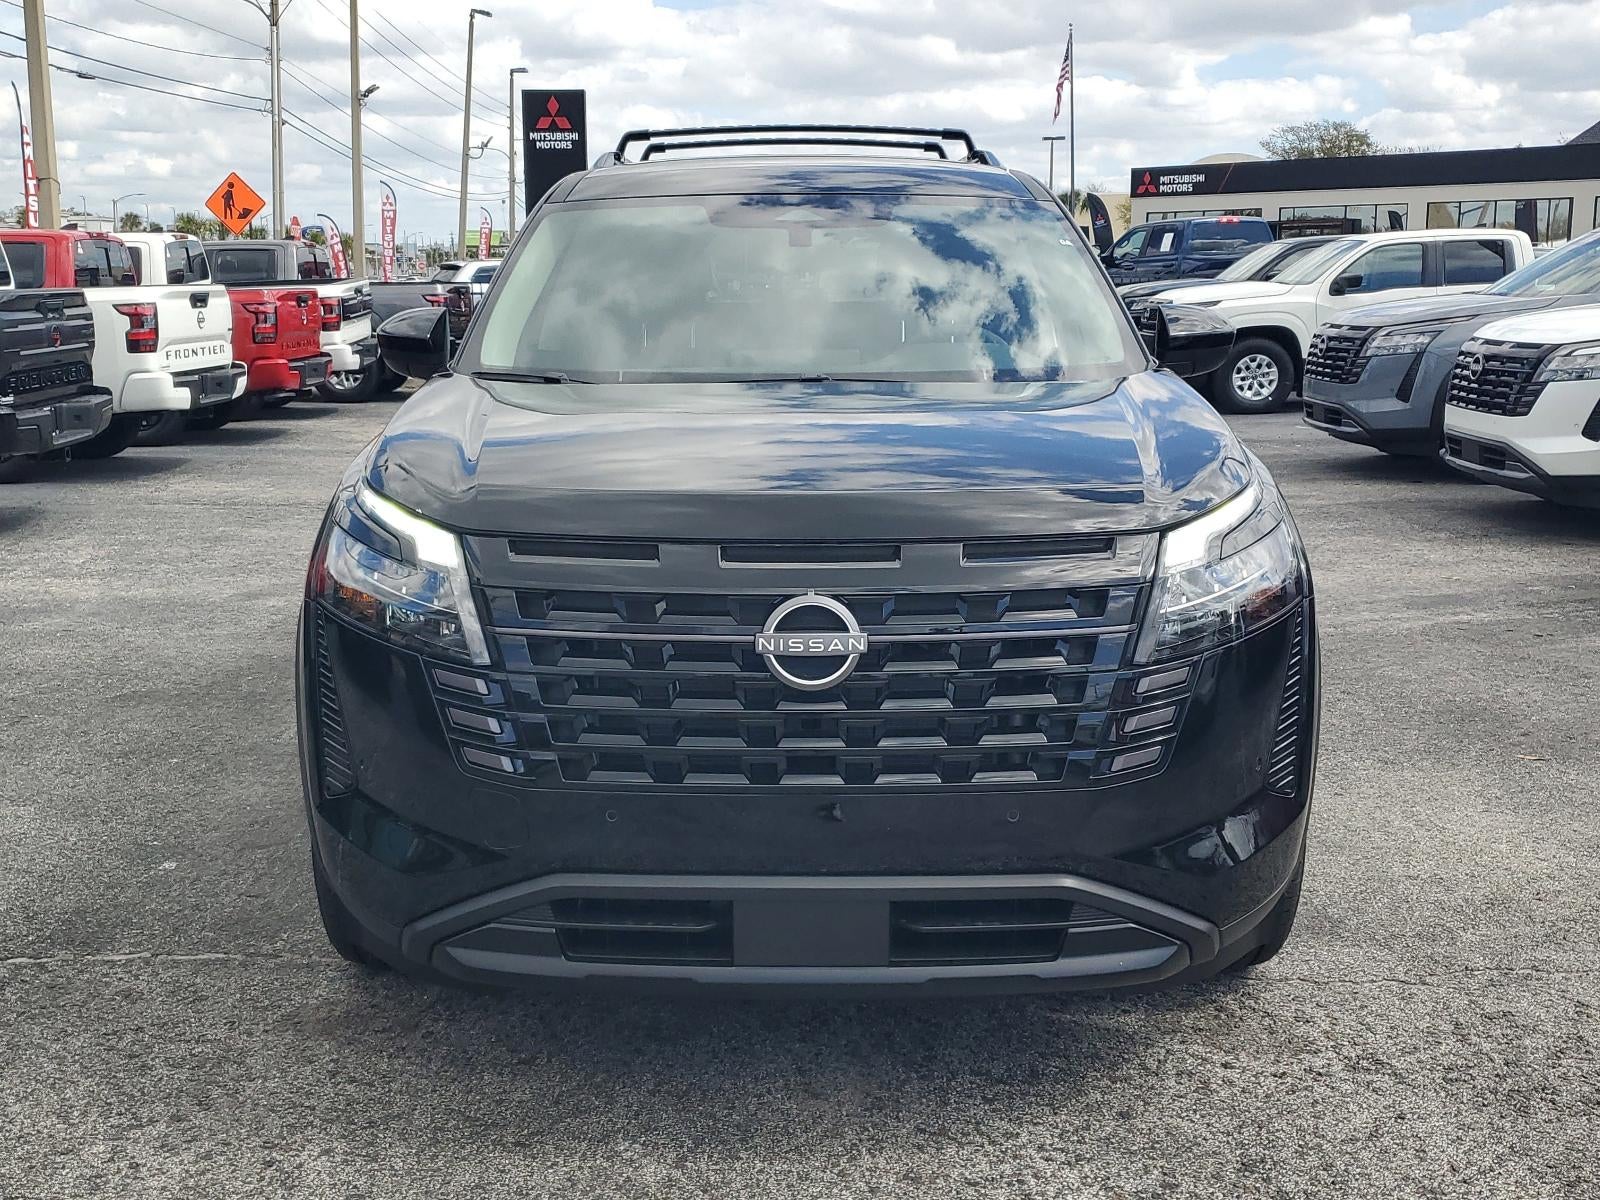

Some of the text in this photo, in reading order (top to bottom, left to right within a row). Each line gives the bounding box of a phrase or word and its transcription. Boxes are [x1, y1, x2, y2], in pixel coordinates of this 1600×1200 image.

[529, 132, 579, 141] MITSUBISHI
[536, 141, 573, 149] MOTORS
[1160, 174, 1206, 184] MITSUBISHI
[1160, 184, 1193, 193] MOTORS
[165, 344, 225, 361] FRONTIER
[758, 637, 865, 652] NISSAN
